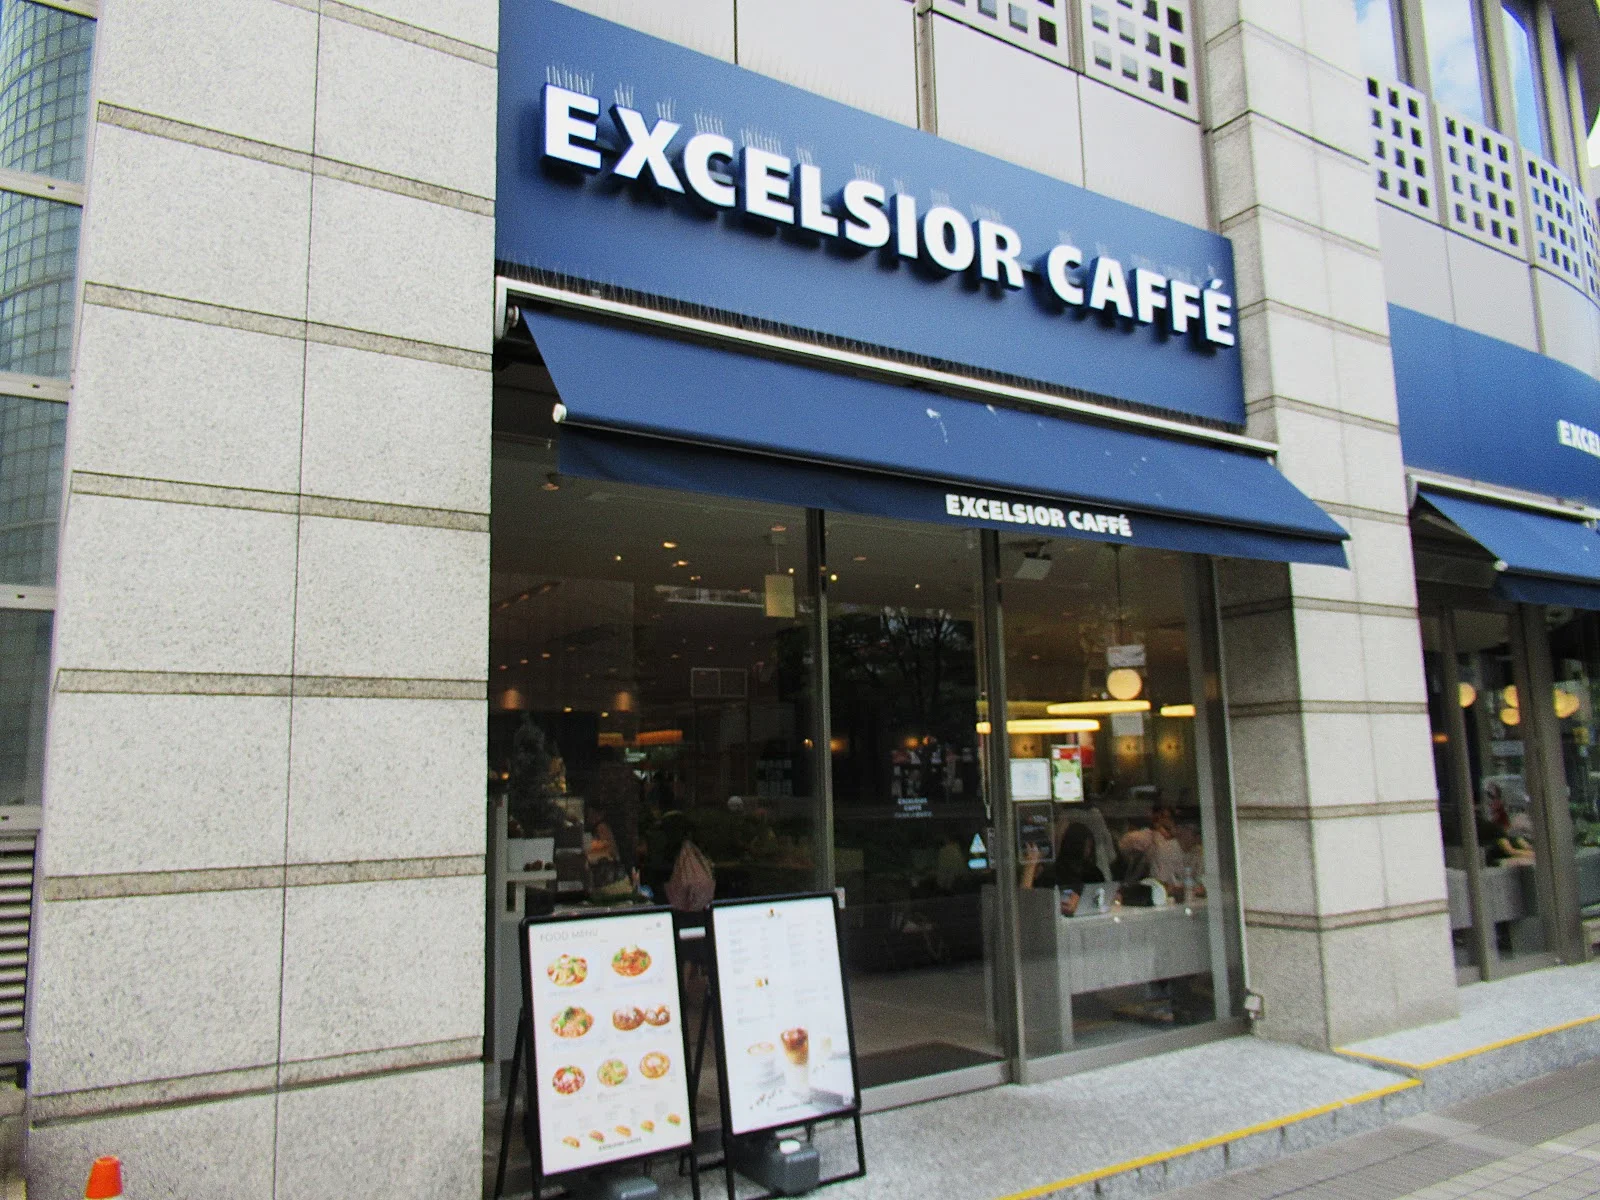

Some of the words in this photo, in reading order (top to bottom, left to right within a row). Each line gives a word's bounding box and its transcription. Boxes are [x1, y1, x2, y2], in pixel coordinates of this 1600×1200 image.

[543, 83, 1025, 290] EXCELSIOR
[1047, 244, 1235, 347] CAFFÉ
[945, 493, 1066, 528] EXCELSIOR
[1068, 510, 1133, 538] CAFFÉ
[540, 931, 569, 942] FOOD
[571, 928, 599, 939] MENU
